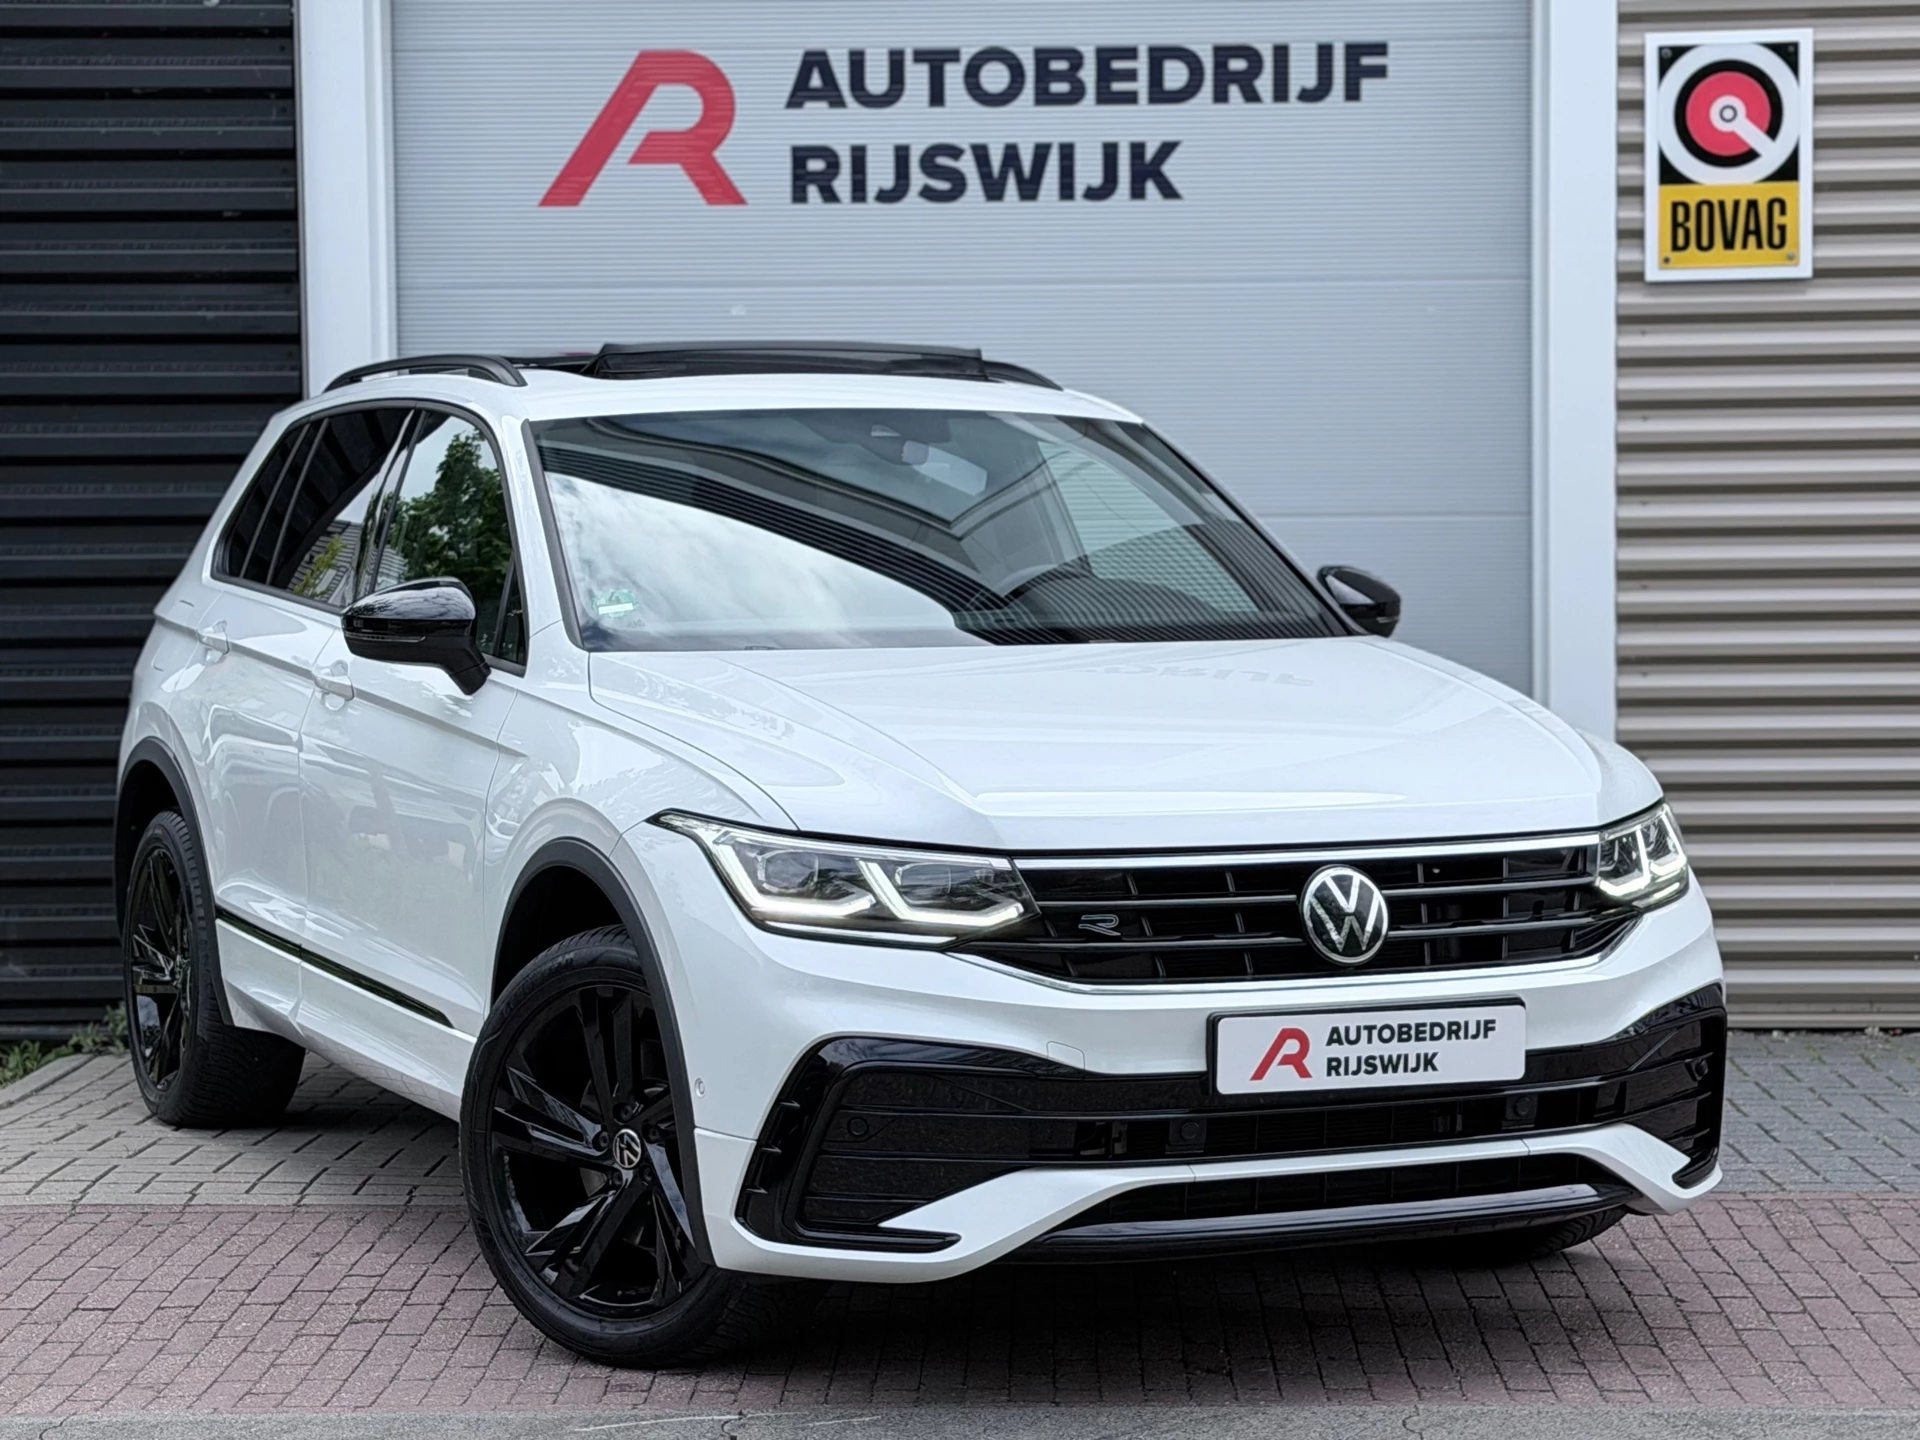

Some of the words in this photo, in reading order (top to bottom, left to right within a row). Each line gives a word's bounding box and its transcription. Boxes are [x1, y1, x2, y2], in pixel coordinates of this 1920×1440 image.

[785, 42, 1390, 109] AUTOBEDRIJF
[790, 140, 1184, 204] RIJSWIJK
[1670, 197, 1788, 252] BOVAG
[1325, 1019, 1497, 1047] AUTOBEDRIJF
[1325, 1052, 1439, 1077] RIJSWIJK
